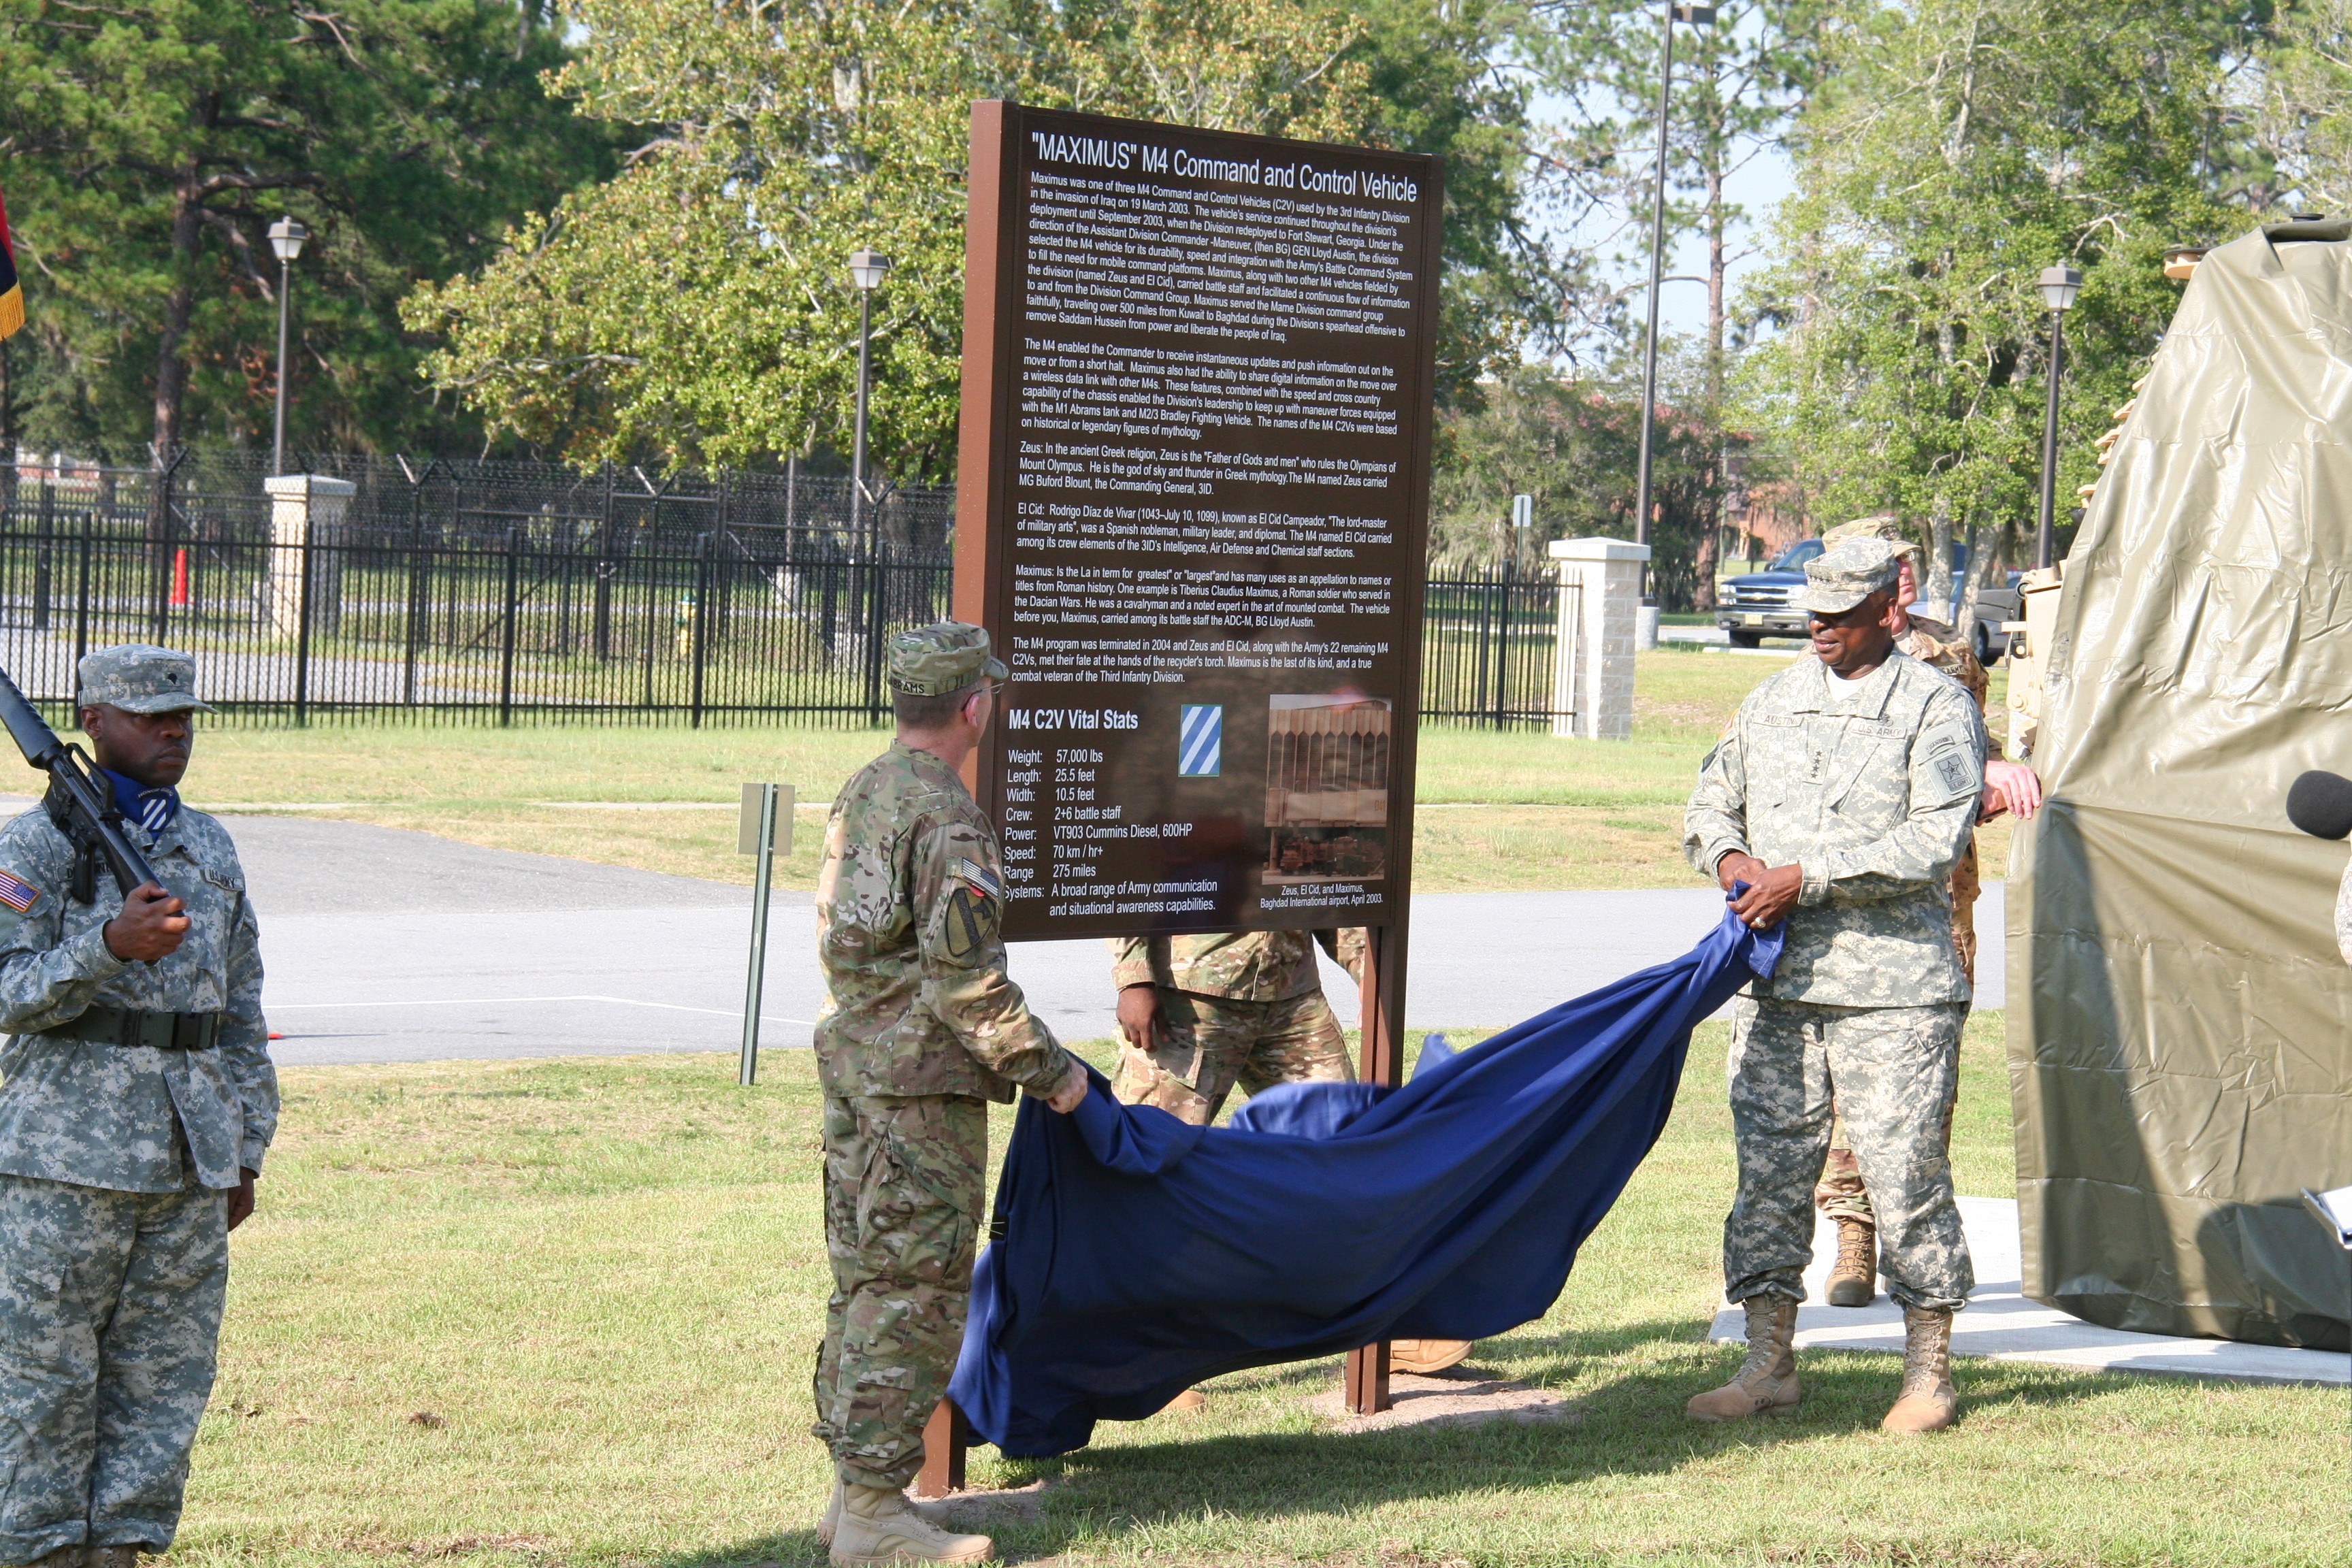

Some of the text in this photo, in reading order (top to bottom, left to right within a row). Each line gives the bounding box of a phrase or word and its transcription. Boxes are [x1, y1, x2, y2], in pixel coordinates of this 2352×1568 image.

[1032, 131, 1417, 203] "MAXIMUS" M4 Command and Control Vehicle
[1030, 171, 1410, 224] Maximus was one of three M4 Command and Control Vehicles (C2V) used by the 3rd Infantry Division
[1024, 337, 1394, 377] The M4 enabled the Commander to receive instantaneous updates and push information out on the
[1021, 416, 1202, 440] on historical or legendary figures of mythology.
[1019, 473, 1214, 496] MG Buford Blount, the Commanding General, 3ID.
[1016, 536, 1355, 558] among its crew elements of the 3ID's Intelligence, Air Defense and Chemical staff sections.
[1013, 610, 1316, 630] before you, Maximus, carried among its battle staff the ADC-M, BG Lloyd Austin.
[1011, 668, 1186, 685] combat veteran of the Third Infantry Division.
[1009, 708, 1139, 730] M4 C2V Vital Stats
[1764, 715, 1796, 725] AUSTIN
[1008, 749, 1103, 767] Weight: 57,000 lbs
[1007, 768, 1095, 786] Length: 25.5 feet
[1006, 787, 1095, 802] Width: 10.5 feet
[1005, 805, 1122, 821] Crew: 2+6 battle staff
[1005, 823, 1193, 840] Power: VT903 Cummins Diesel, 600HP
[1004, 845, 1036, 864] Speed:
[1053, 845, 1064, 859] 70
[1066, 845, 1081, 858] km
[1088, 844, 1103, 858] hr+
[1004, 863, 1096, 883] Range 275 miles
[1051, 883, 1059, 897] A
[1061, 882, 1088, 897] broad
[1089, 884, 1115, 899] range
[1117, 880, 1127, 895] of
[1127, 881, 1152, 897] Army
[1153, 878, 1218, 894] communication
[1281, 883, 1365, 896] Zeus, El Cid, and Maximus,
[1049, 896, 1216, 917] and situational awareness capabilities.
[1260, 893, 1384, 911] Baghdad International airport, April 2003.
